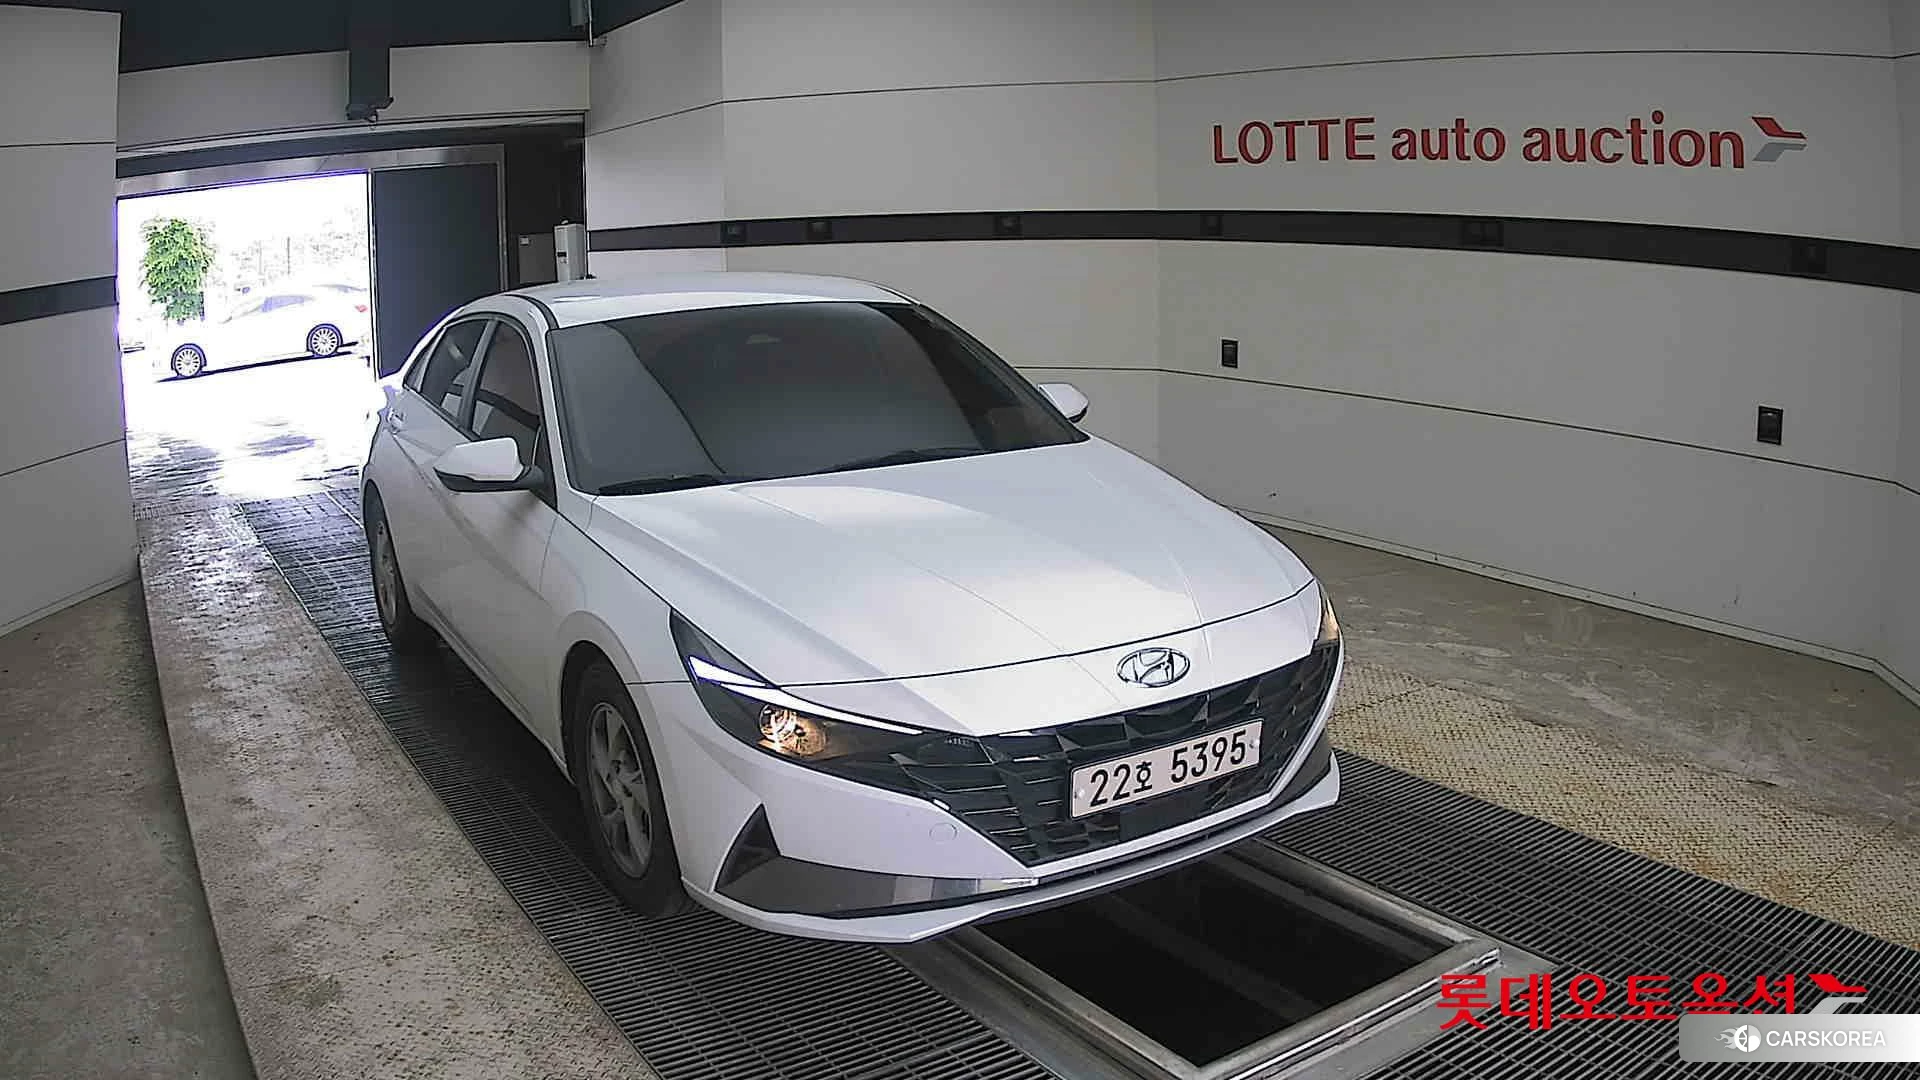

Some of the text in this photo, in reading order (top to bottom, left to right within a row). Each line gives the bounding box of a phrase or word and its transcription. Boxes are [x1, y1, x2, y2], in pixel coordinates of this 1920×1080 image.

[1212, 109, 1746, 169] LOTTE auto auction
[1089, 729, 1248, 807] 22호 5395
